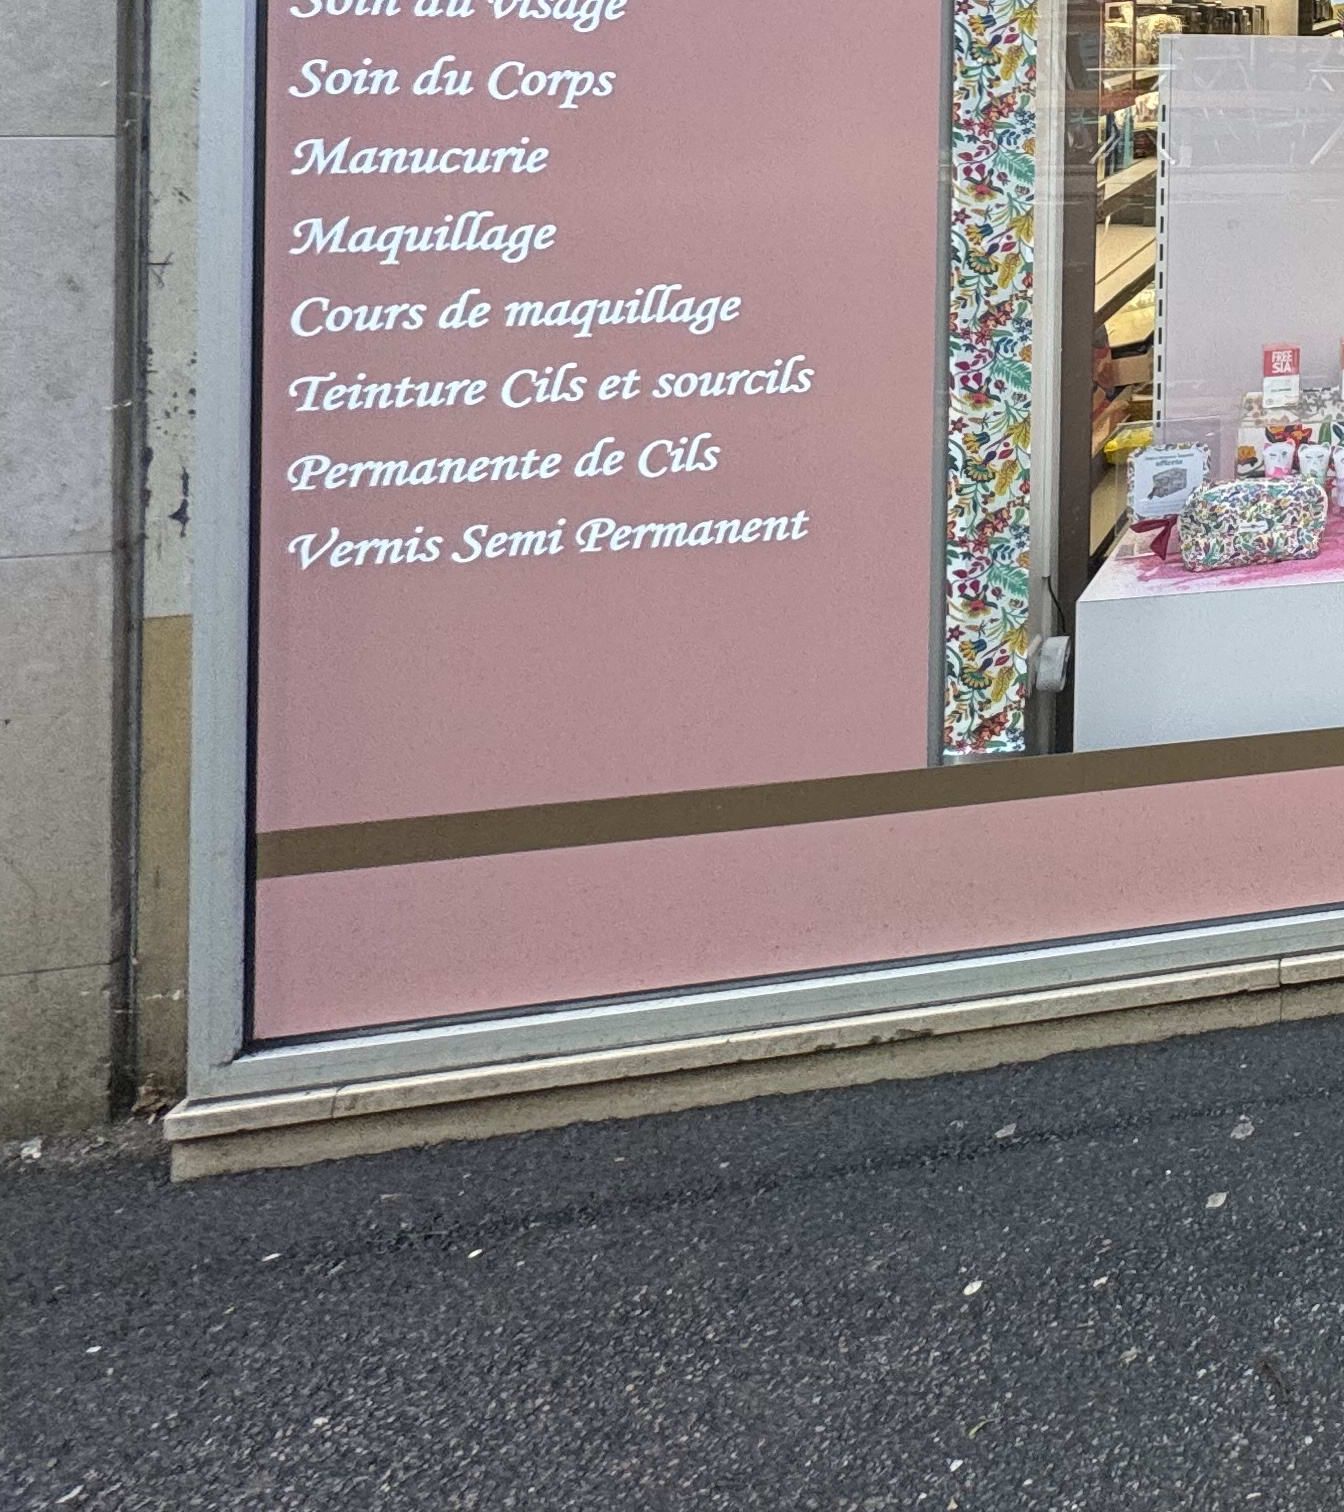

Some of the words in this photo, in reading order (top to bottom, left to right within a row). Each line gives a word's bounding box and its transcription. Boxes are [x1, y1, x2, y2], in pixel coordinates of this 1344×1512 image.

[288, 58, 400, 99] Soin
[411, 54, 474, 97] du
[486, 60, 617, 109] Corps
[290, 136, 549, 175] Manucurie
[289, 210, 557, 265] Maquillage
[290, 296, 427, 337] Cours
[437, 288, 492, 331] de
[503, 283, 742, 337] maquillage
[288, 371, 487, 412] Teinture
[500, 361, 588, 410] Cils
[598, 371, 641, 402] et
[651, 354, 816, 400] sourcils
[1272, 351, 1293, 363] FREE
[1272, 362, 1291, 373] SIA
[286, 451, 563, 492] Permanente
[573, 436, 623, 476] de
[636, 433, 721, 479] Cils
[288, 530, 443, 571] Vernis
[451, 518, 566, 564] Semi
[575, 509, 809, 555] Permanent
